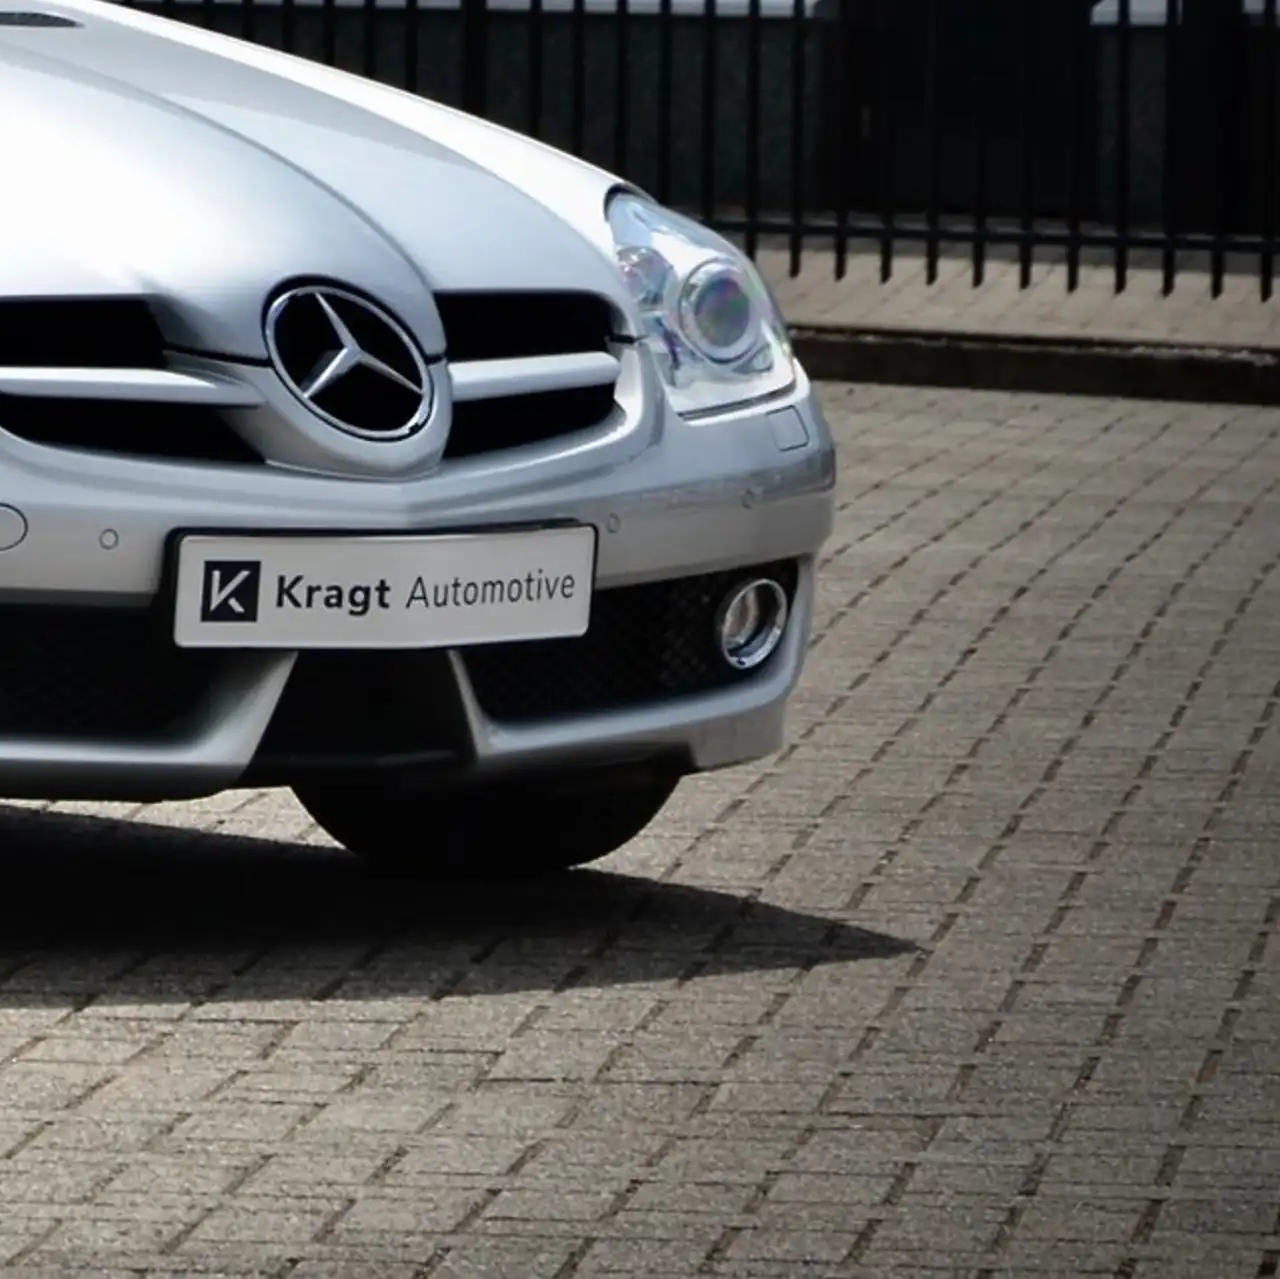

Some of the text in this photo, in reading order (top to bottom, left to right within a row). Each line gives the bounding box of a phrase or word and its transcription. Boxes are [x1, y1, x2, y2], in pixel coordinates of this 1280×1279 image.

[208, 568, 254, 615] K
[275, 569, 576, 617] Kragt Automotive
